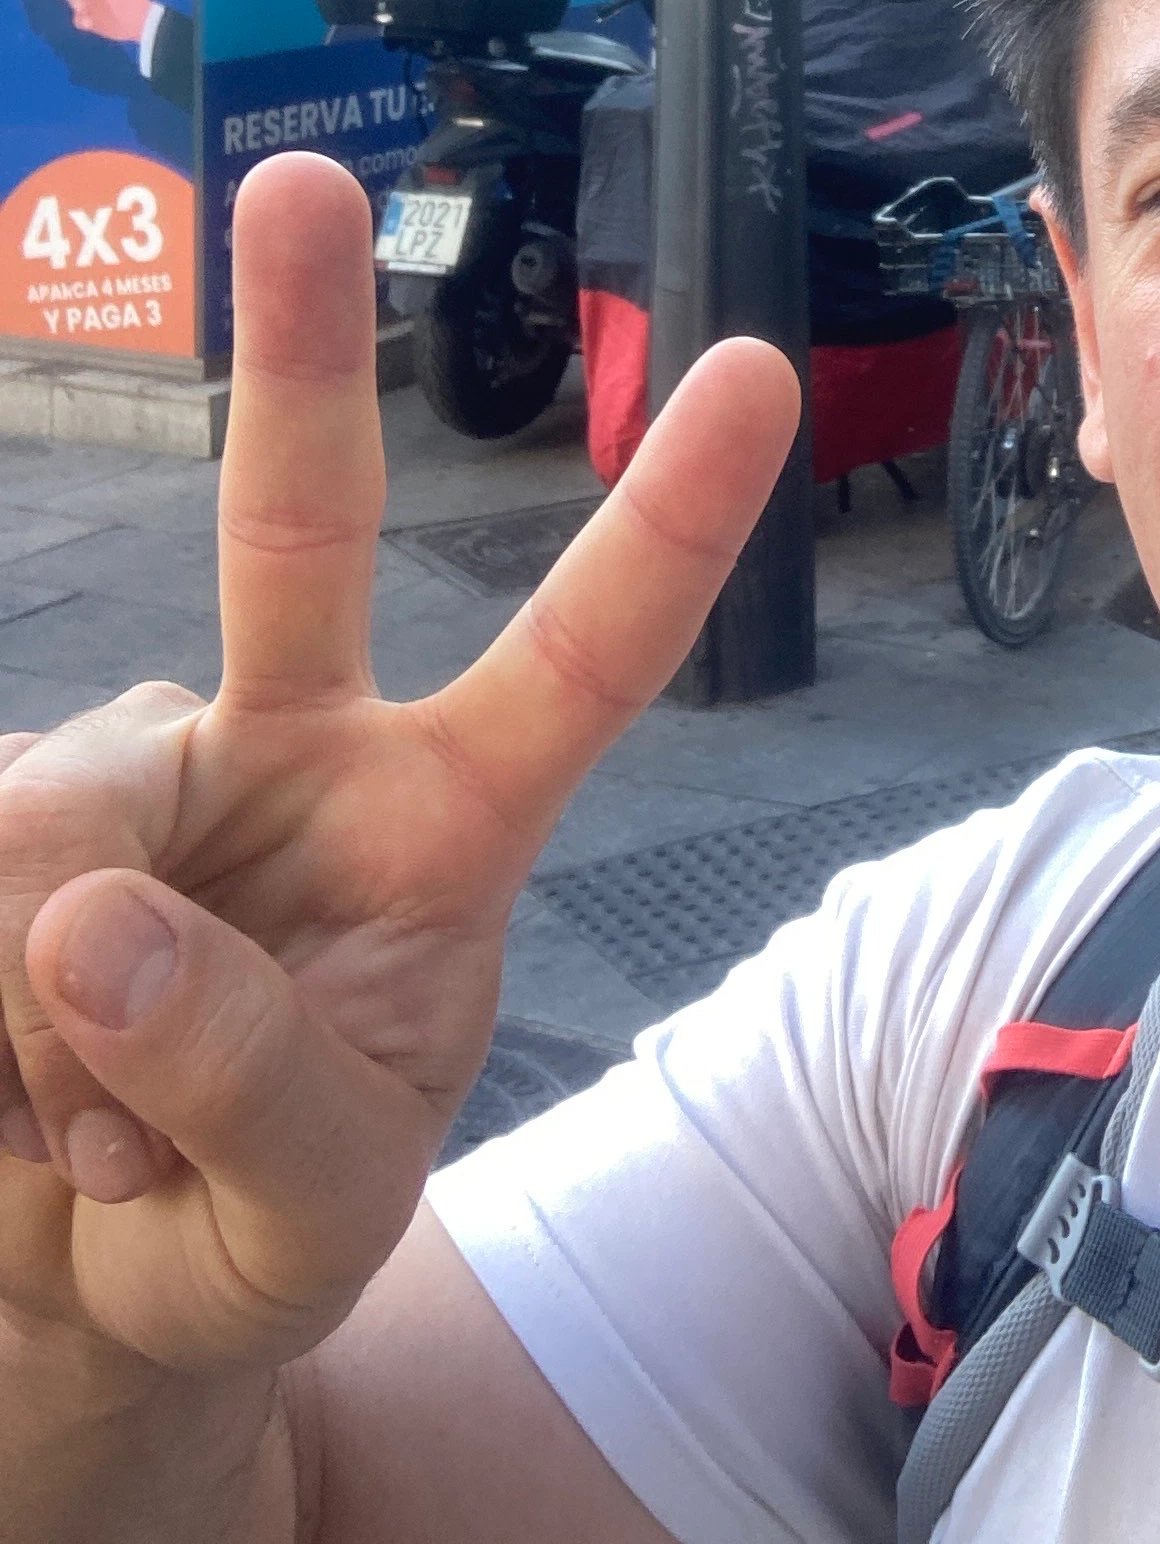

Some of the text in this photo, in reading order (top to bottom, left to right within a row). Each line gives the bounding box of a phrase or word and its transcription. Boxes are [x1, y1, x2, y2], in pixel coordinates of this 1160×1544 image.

[224, 94, 364, 155] RESERVA
[369, 81, 407, 125] TU
[22, 184, 165, 271] 4x3
[403, 198, 464, 229] 2021
[394, 229, 444, 259] LPZ
[27, 270, 173, 305] APARCA 4 MESES
[42, 298, 163, 335] Y PAGA 3
